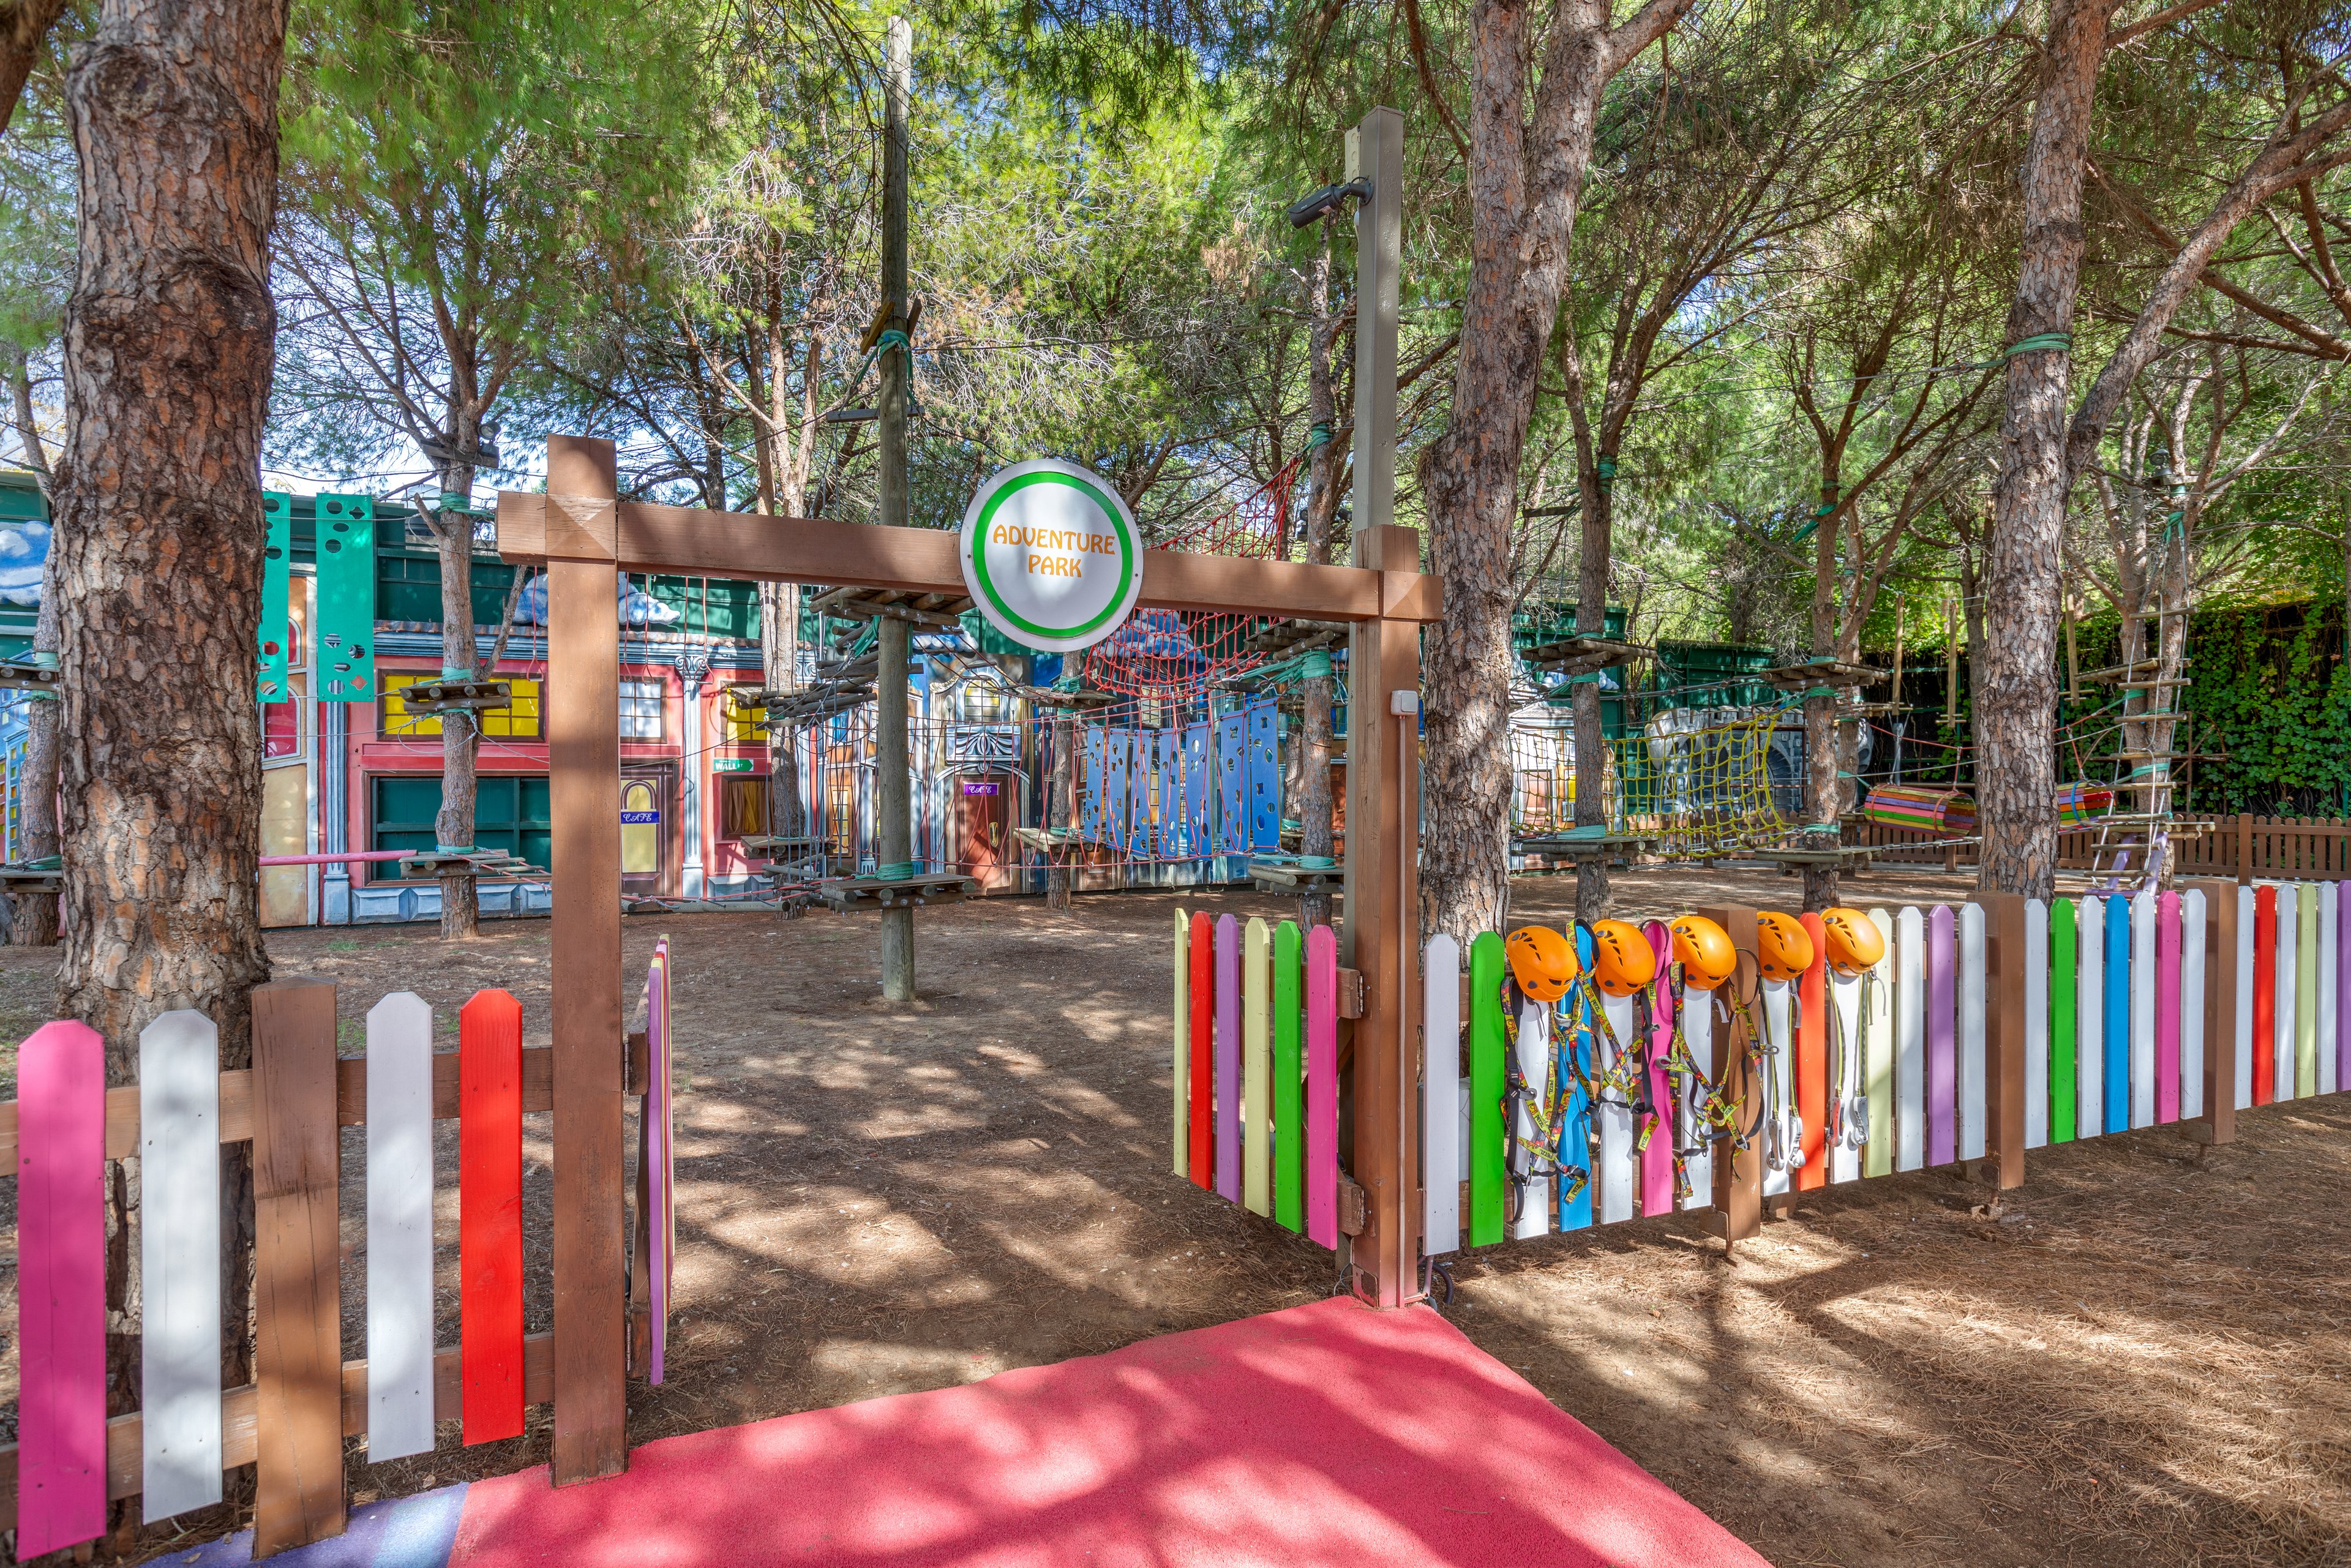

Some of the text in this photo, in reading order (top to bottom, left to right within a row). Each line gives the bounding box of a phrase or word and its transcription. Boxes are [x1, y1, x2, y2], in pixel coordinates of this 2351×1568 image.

[993, 524, 1116, 555] ADVENTURE
[1028, 554, 1082, 578] PARK
[623, 813, 652, 822] CAFE
[1591, 1000, 1600, 1012] PETZL
[1535, 1115, 1544, 1128] PETZL
[1640, 1135, 1649, 1149] PETZL
[1572, 1183, 1582, 1196] PETZL
